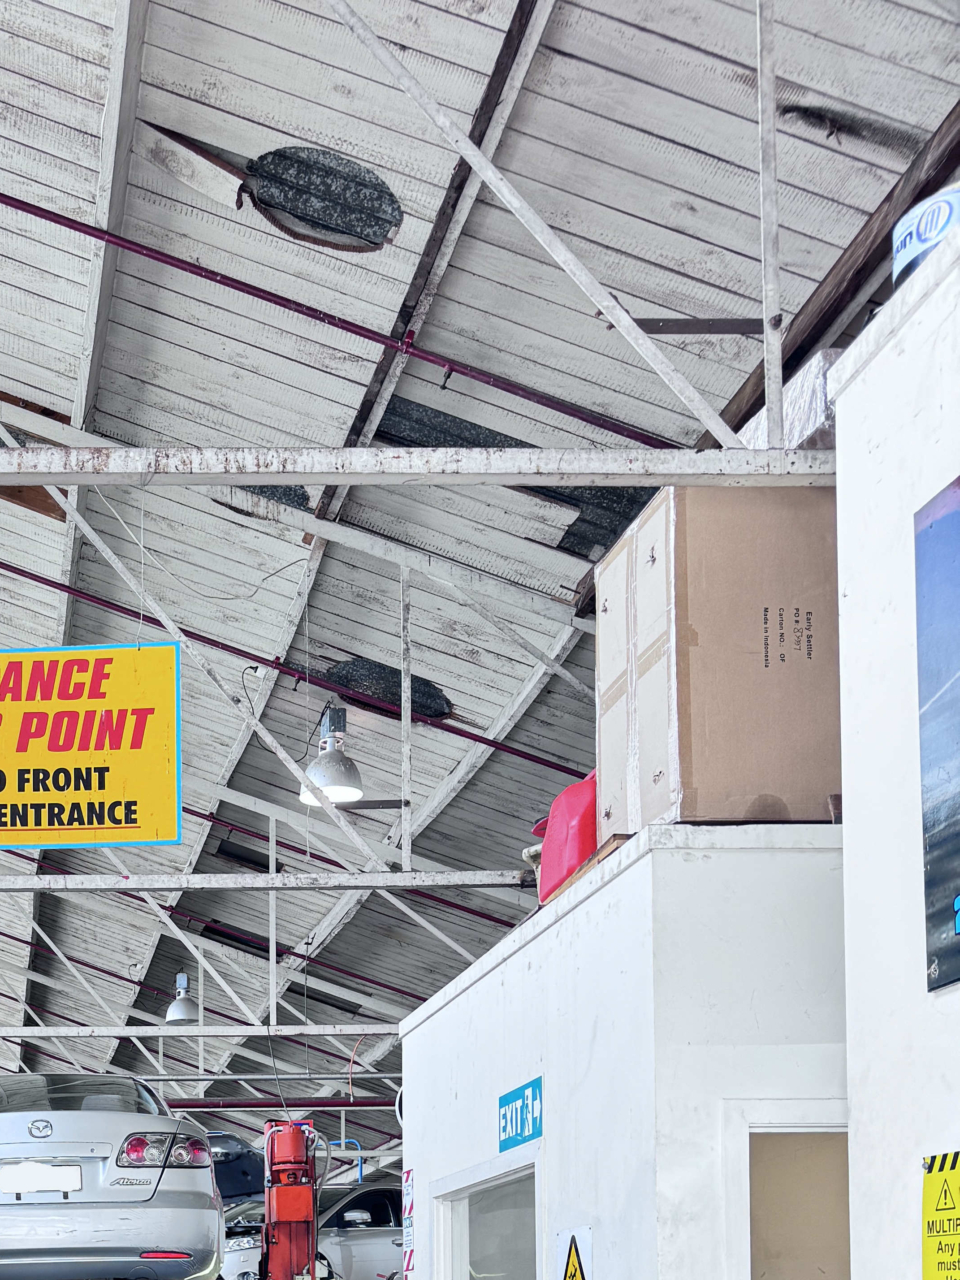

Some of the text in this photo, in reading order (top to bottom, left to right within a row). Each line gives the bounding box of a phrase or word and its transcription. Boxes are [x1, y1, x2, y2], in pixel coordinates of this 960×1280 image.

[794, 607, 800, 618] PO
[805, 611, 813, 632] Early
[764, 626, 769, 634] in
[779, 653, 786, 663] OF
[15, 707, 156, 753] POINT
[17, 766, 110, 793] FRONT
[499, 1098, 523, 1141] EXIT
[936, 1240, 956, 1257] Any
